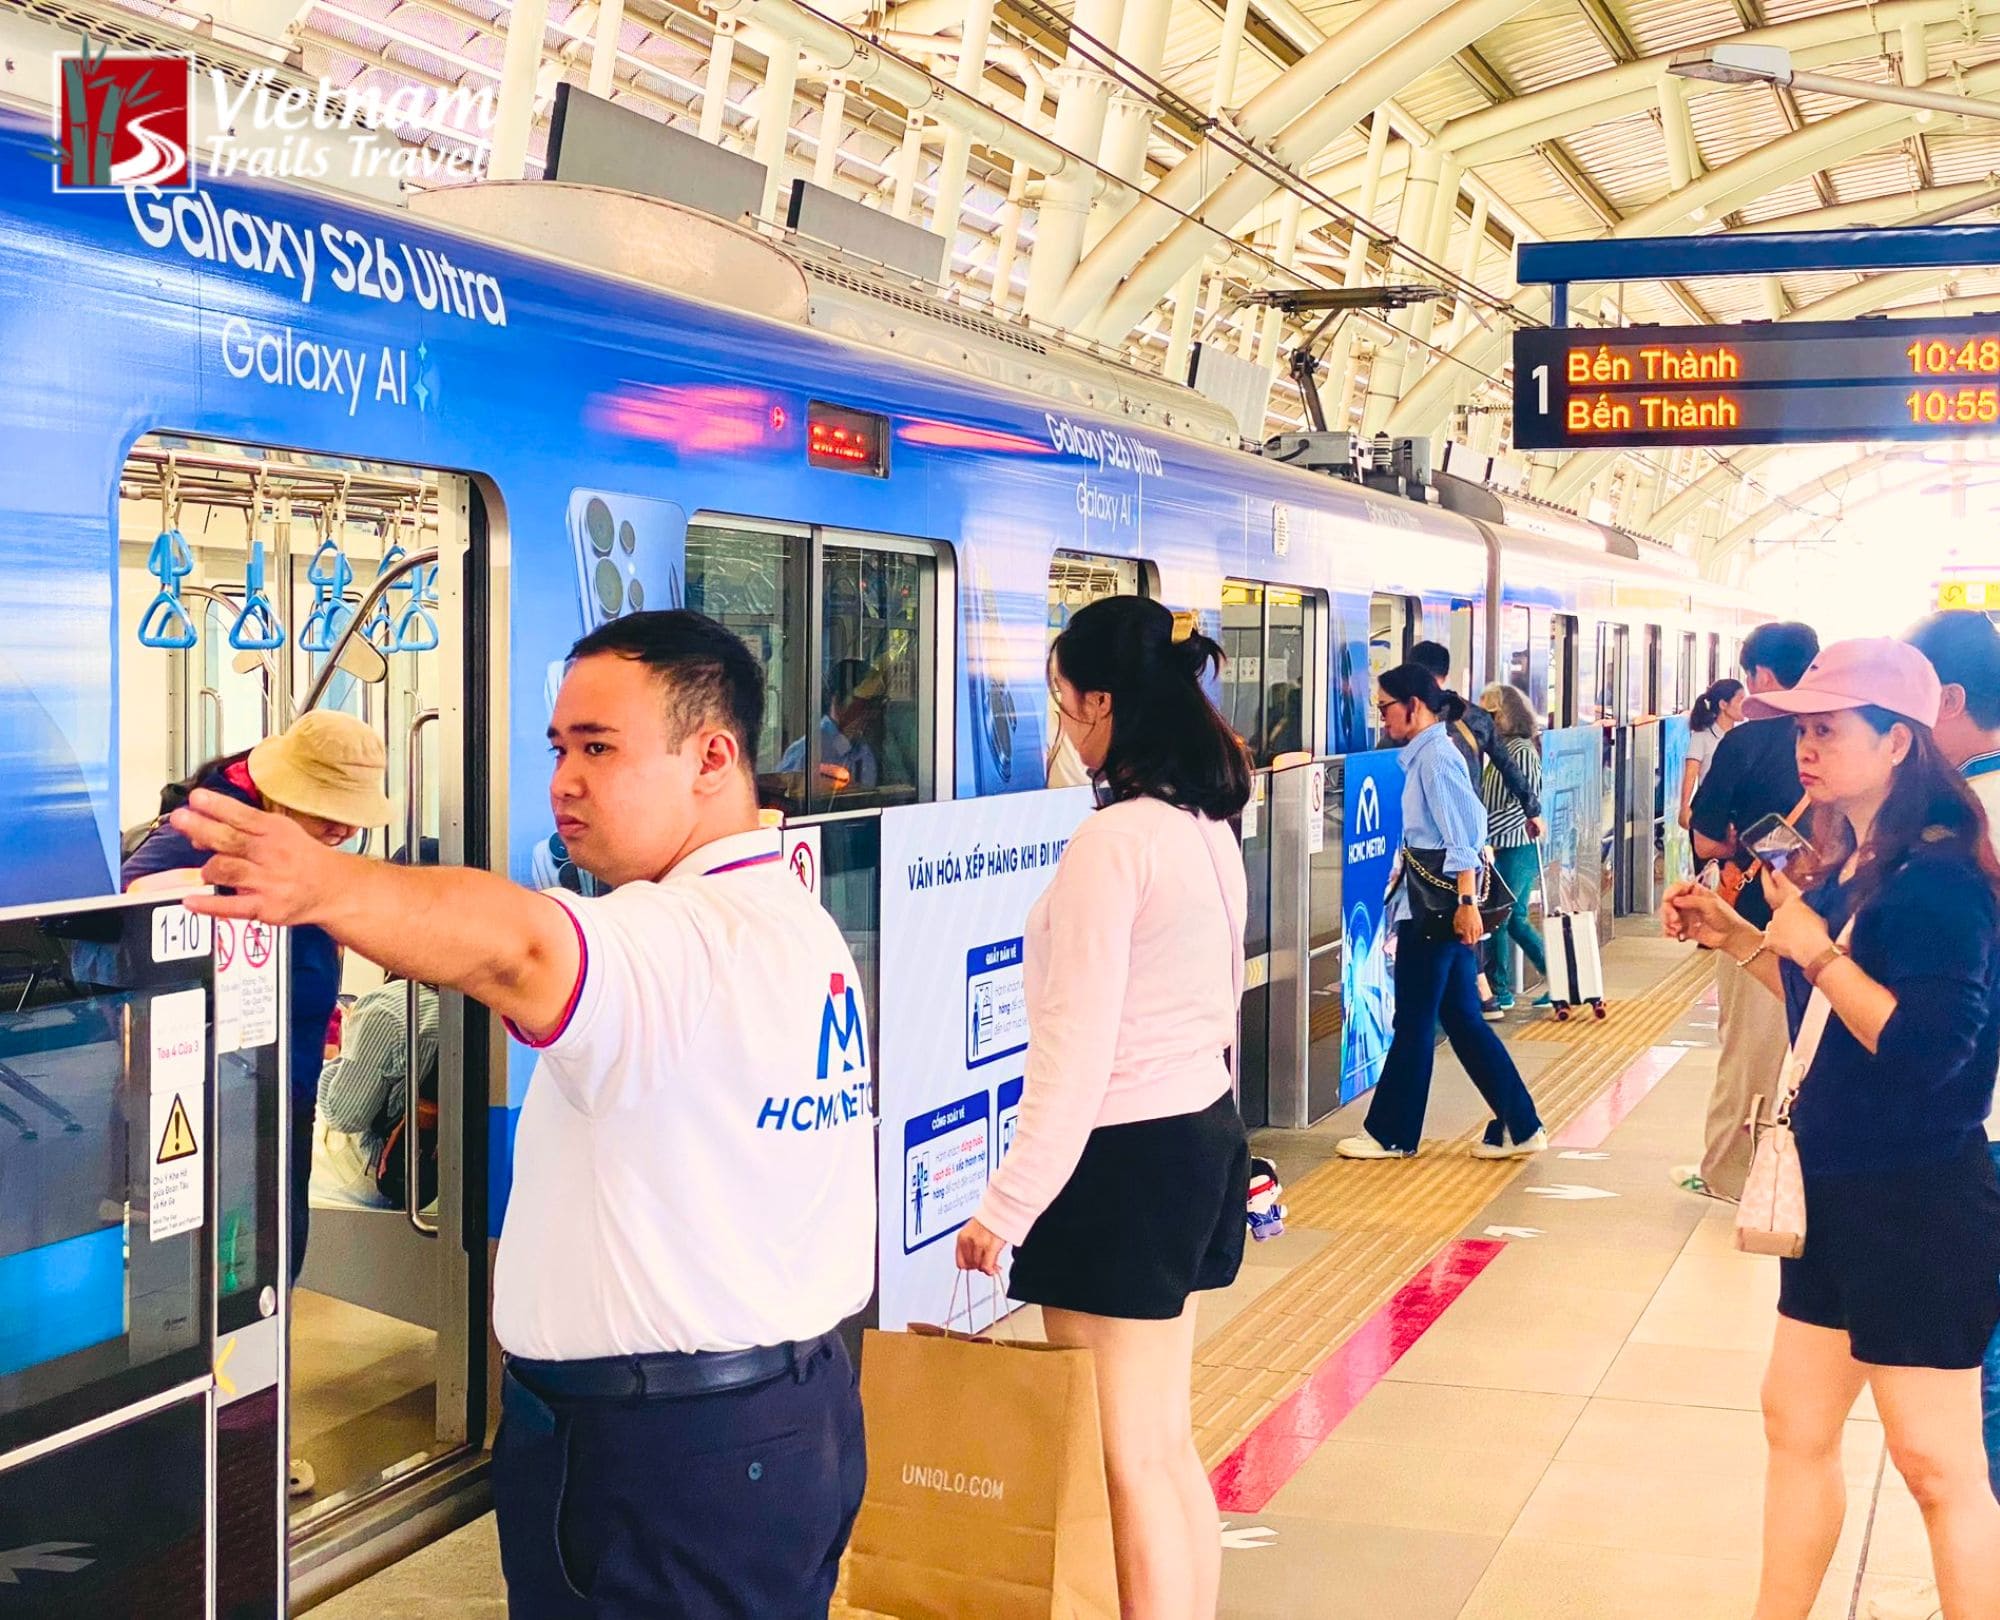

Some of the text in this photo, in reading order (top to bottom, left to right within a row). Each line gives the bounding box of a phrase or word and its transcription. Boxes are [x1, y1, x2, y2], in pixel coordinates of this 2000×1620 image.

[124, 184, 508, 327] Galaxy S26 Ultra
[221, 317, 407, 417] Galaxy AI
[1567, 339, 2000, 382] Bến Thành 10:48
[1531, 364, 1549, 415] 1
[1567, 389, 1999, 430] Bến Thành 10:55
[1045, 412, 1163, 477] Galaxy S26 Ultra
[1076, 481, 1118, 533] Galaxy
[908, 856, 933, 891] VĂN
[936, 851, 962, 886] HÓA
[965, 842, 985, 881] XẾP
[987, 843, 1018, 877] HÀNG
[1020, 844, 1037, 871] KHI
[1040, 842, 1050, 867] ĐI
[1366, 835, 1386, 860] METRO
[160, 912, 200, 954] 1-10
[902, 1463, 1005, 1501] UNIQLO.COM
